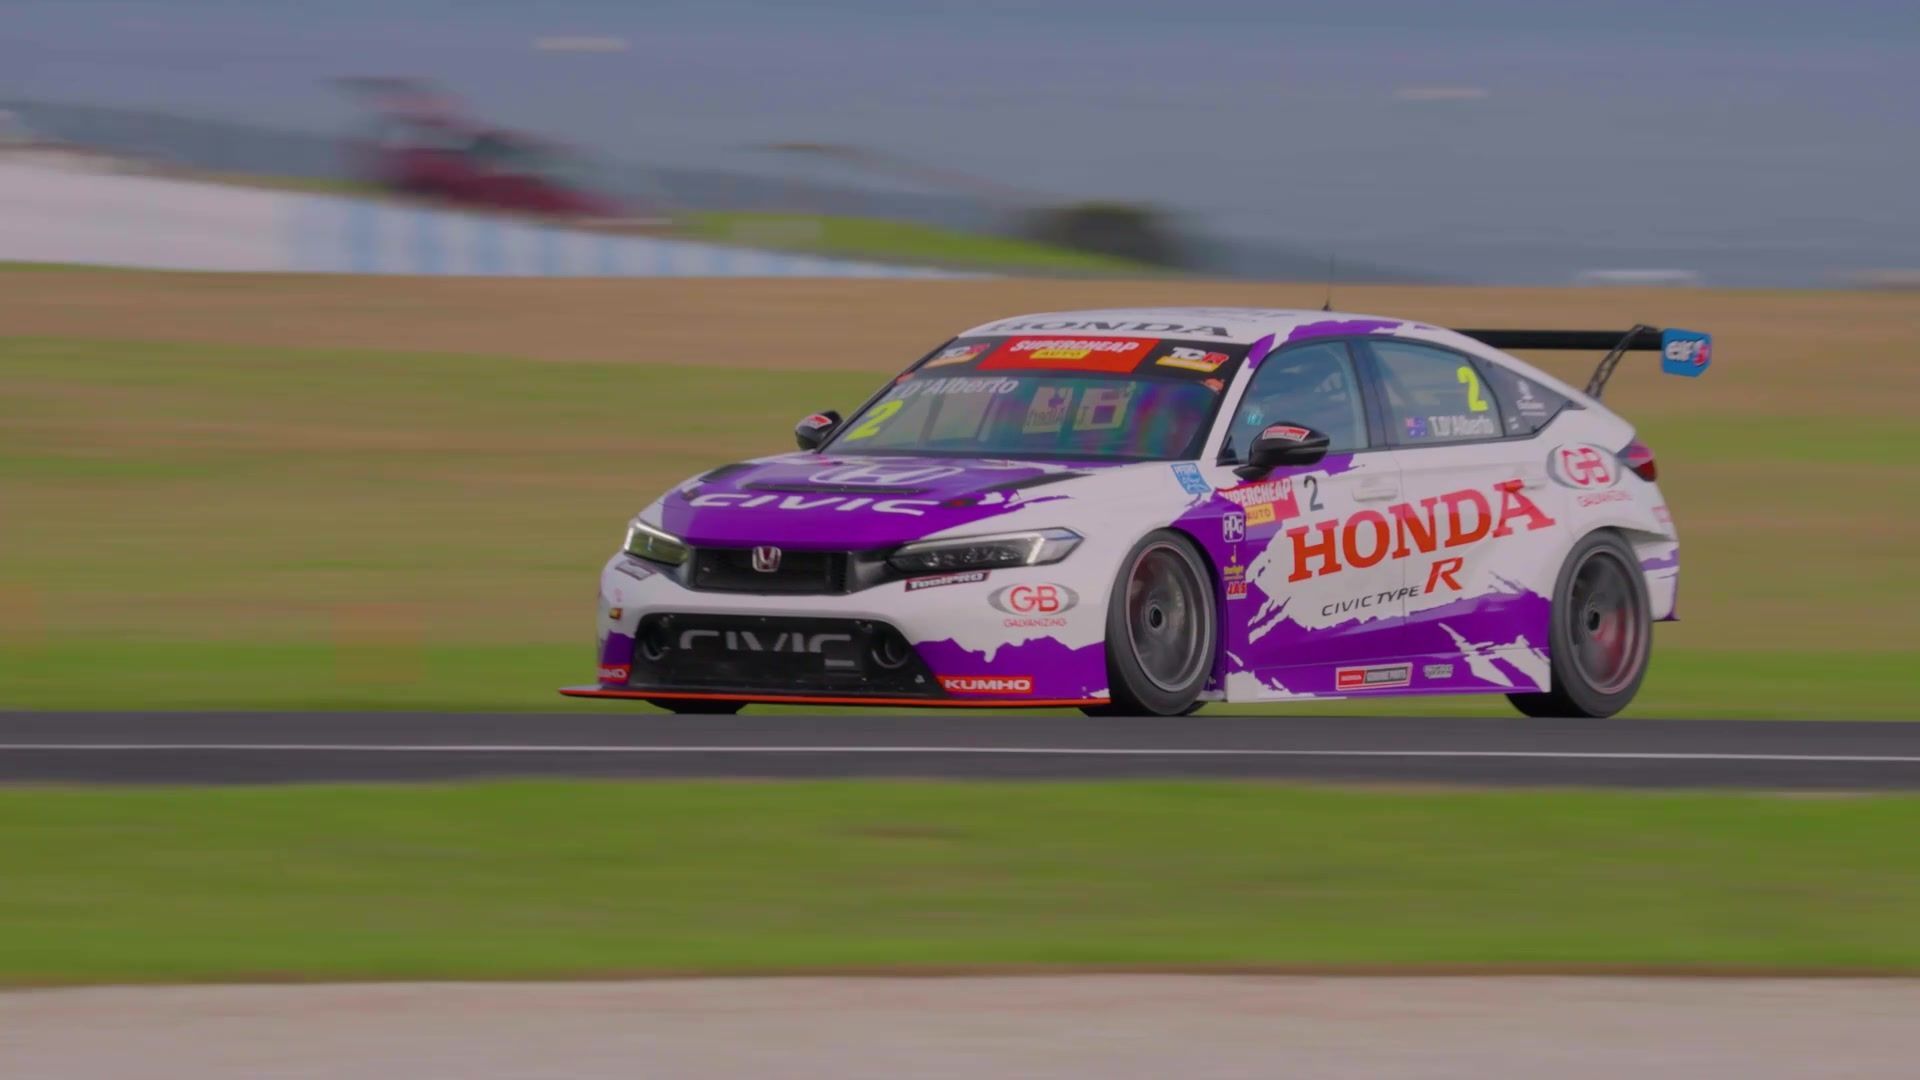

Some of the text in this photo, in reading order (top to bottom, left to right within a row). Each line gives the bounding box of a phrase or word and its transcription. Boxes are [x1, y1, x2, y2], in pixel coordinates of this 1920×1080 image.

[988, 320, 1234, 339] HONDA
[1010, 340, 1140, 353] SUPERCHEAP
[1038, 350, 1083, 358] AUTO
[1456, 366, 1488, 412] 2
[844, 399, 904, 441] 2
[1560, 447, 1611, 486] GB
[690, 493, 940, 516] CIVIC
[1303, 475, 1324, 512] 2
[1224, 514, 1243, 540] PPG
[1286, 479, 1556, 583] HONDA
[1010, 586, 1060, 613] GB
[1321, 557, 1463, 617] CIVIC TYPE R
[1004, 618, 1067, 628] GALVANIZING
[944, 679, 1031, 690] KUMHO
